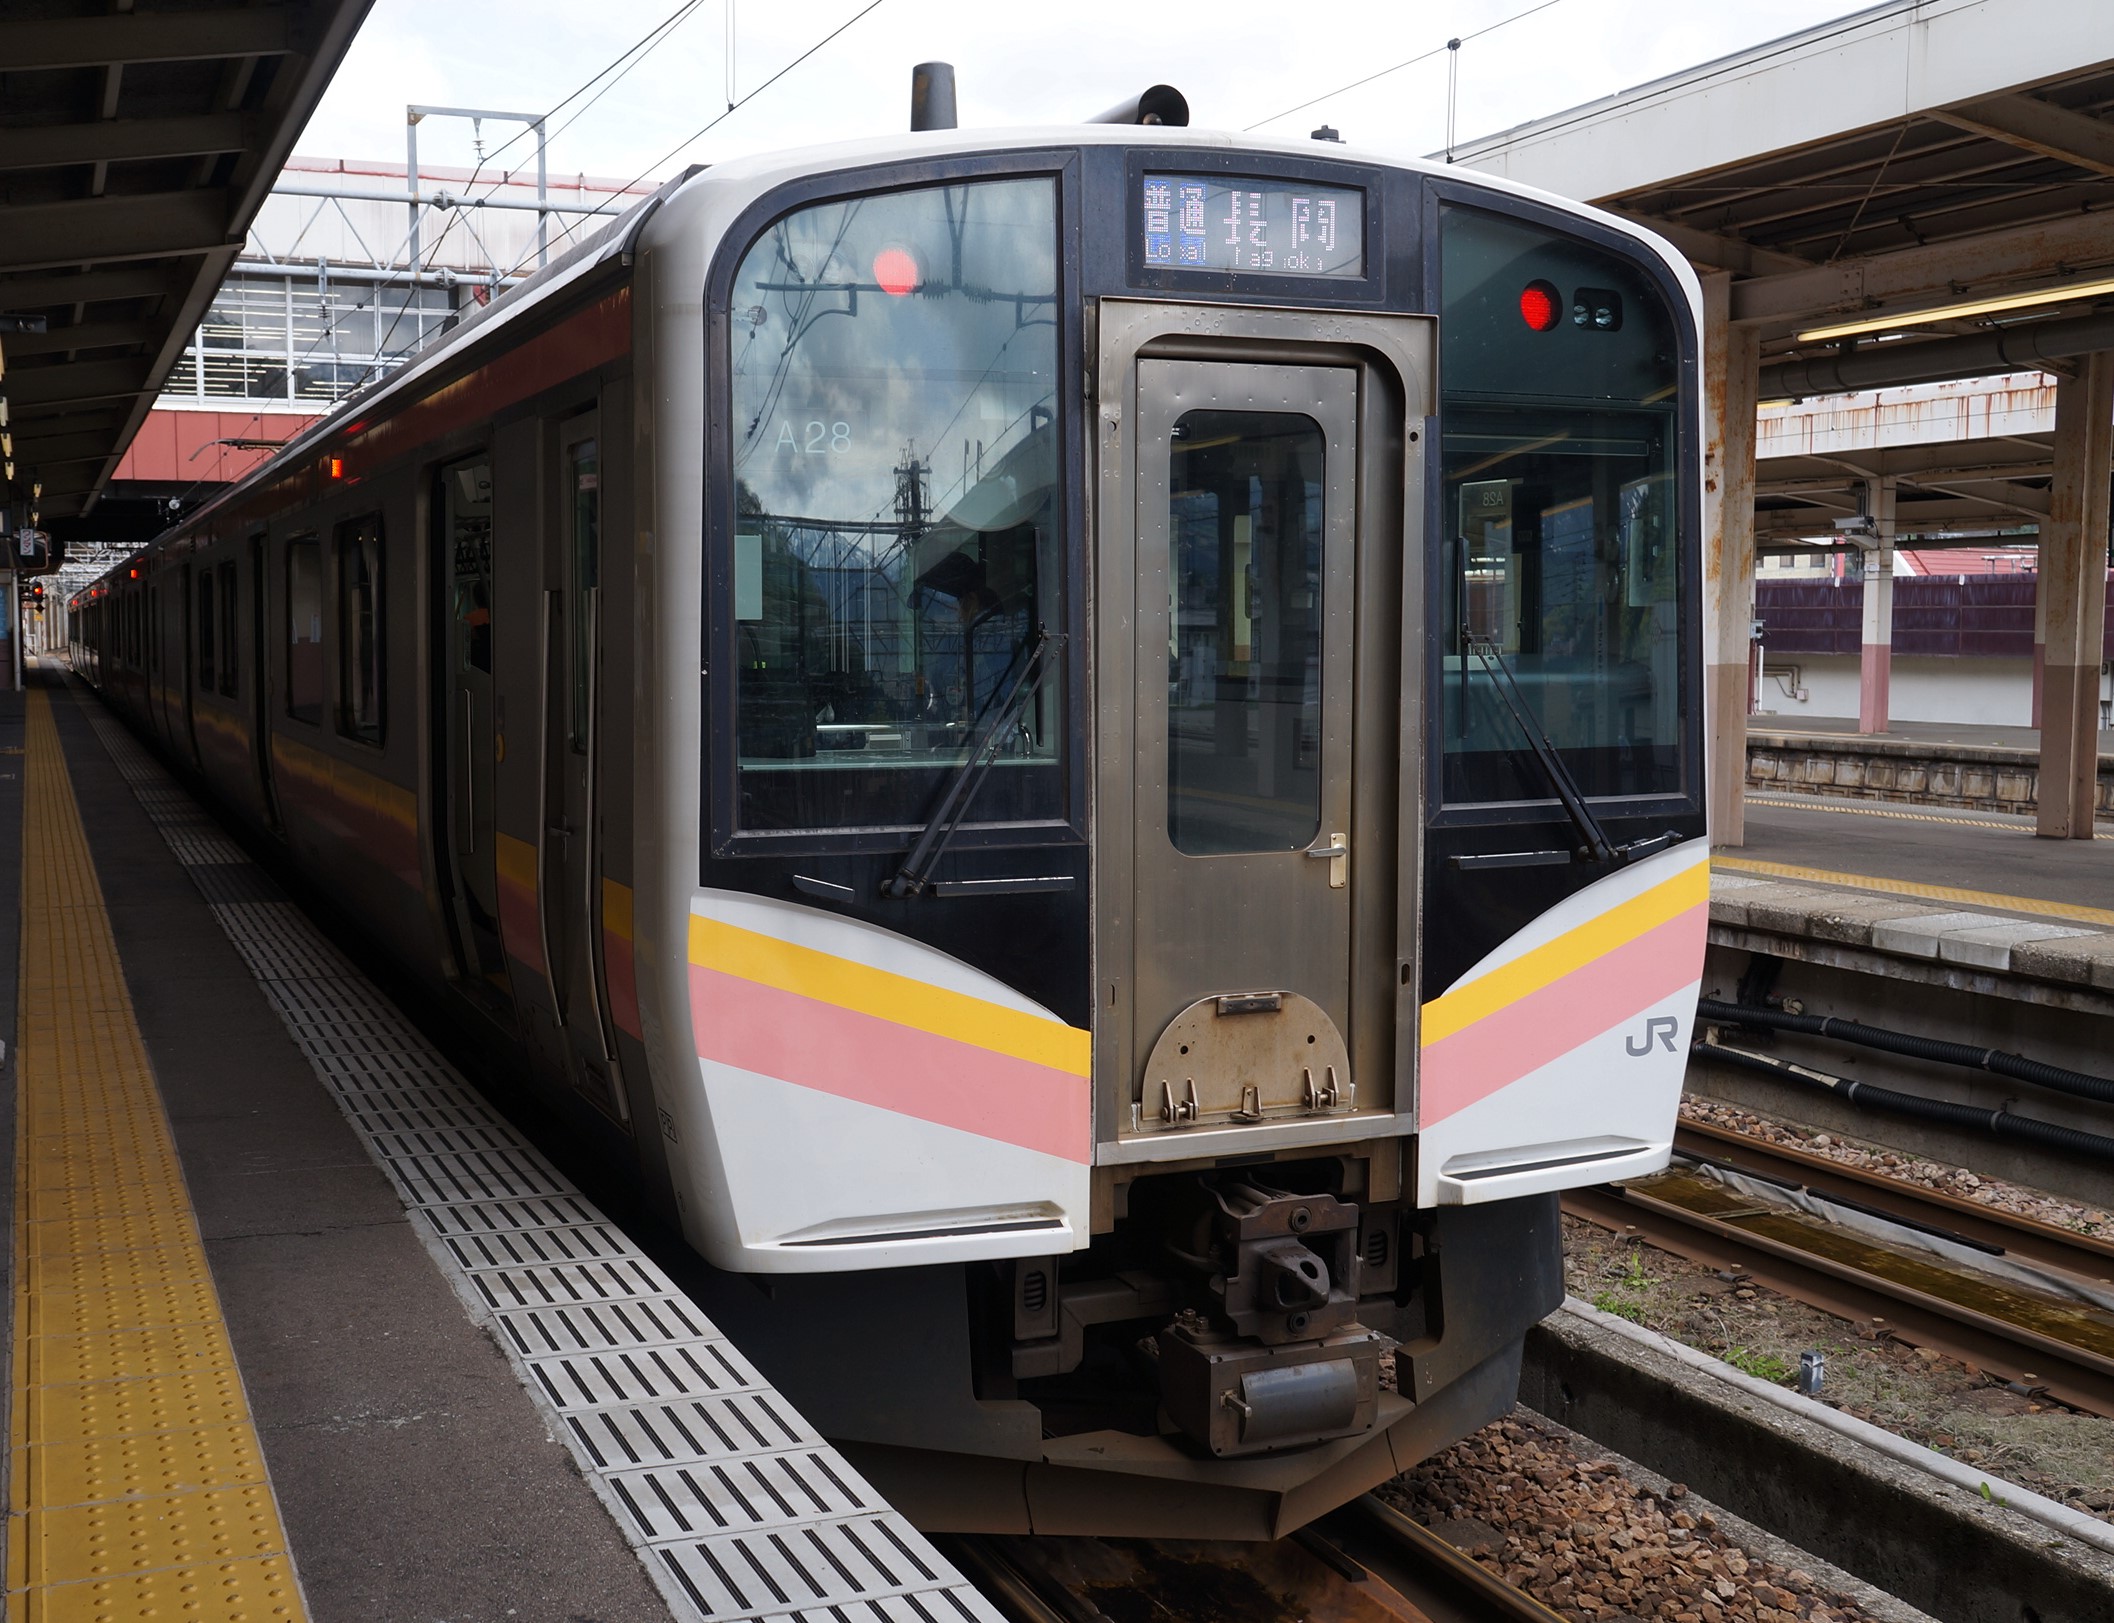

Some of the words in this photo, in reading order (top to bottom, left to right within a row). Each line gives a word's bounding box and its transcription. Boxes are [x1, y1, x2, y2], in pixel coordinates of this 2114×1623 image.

[1144, 184, 1206, 236] 普通
[1236, 246, 1323, 271] agok
[774, 420, 852, 453] A28
[1626, 1015, 1678, 1057] JR
